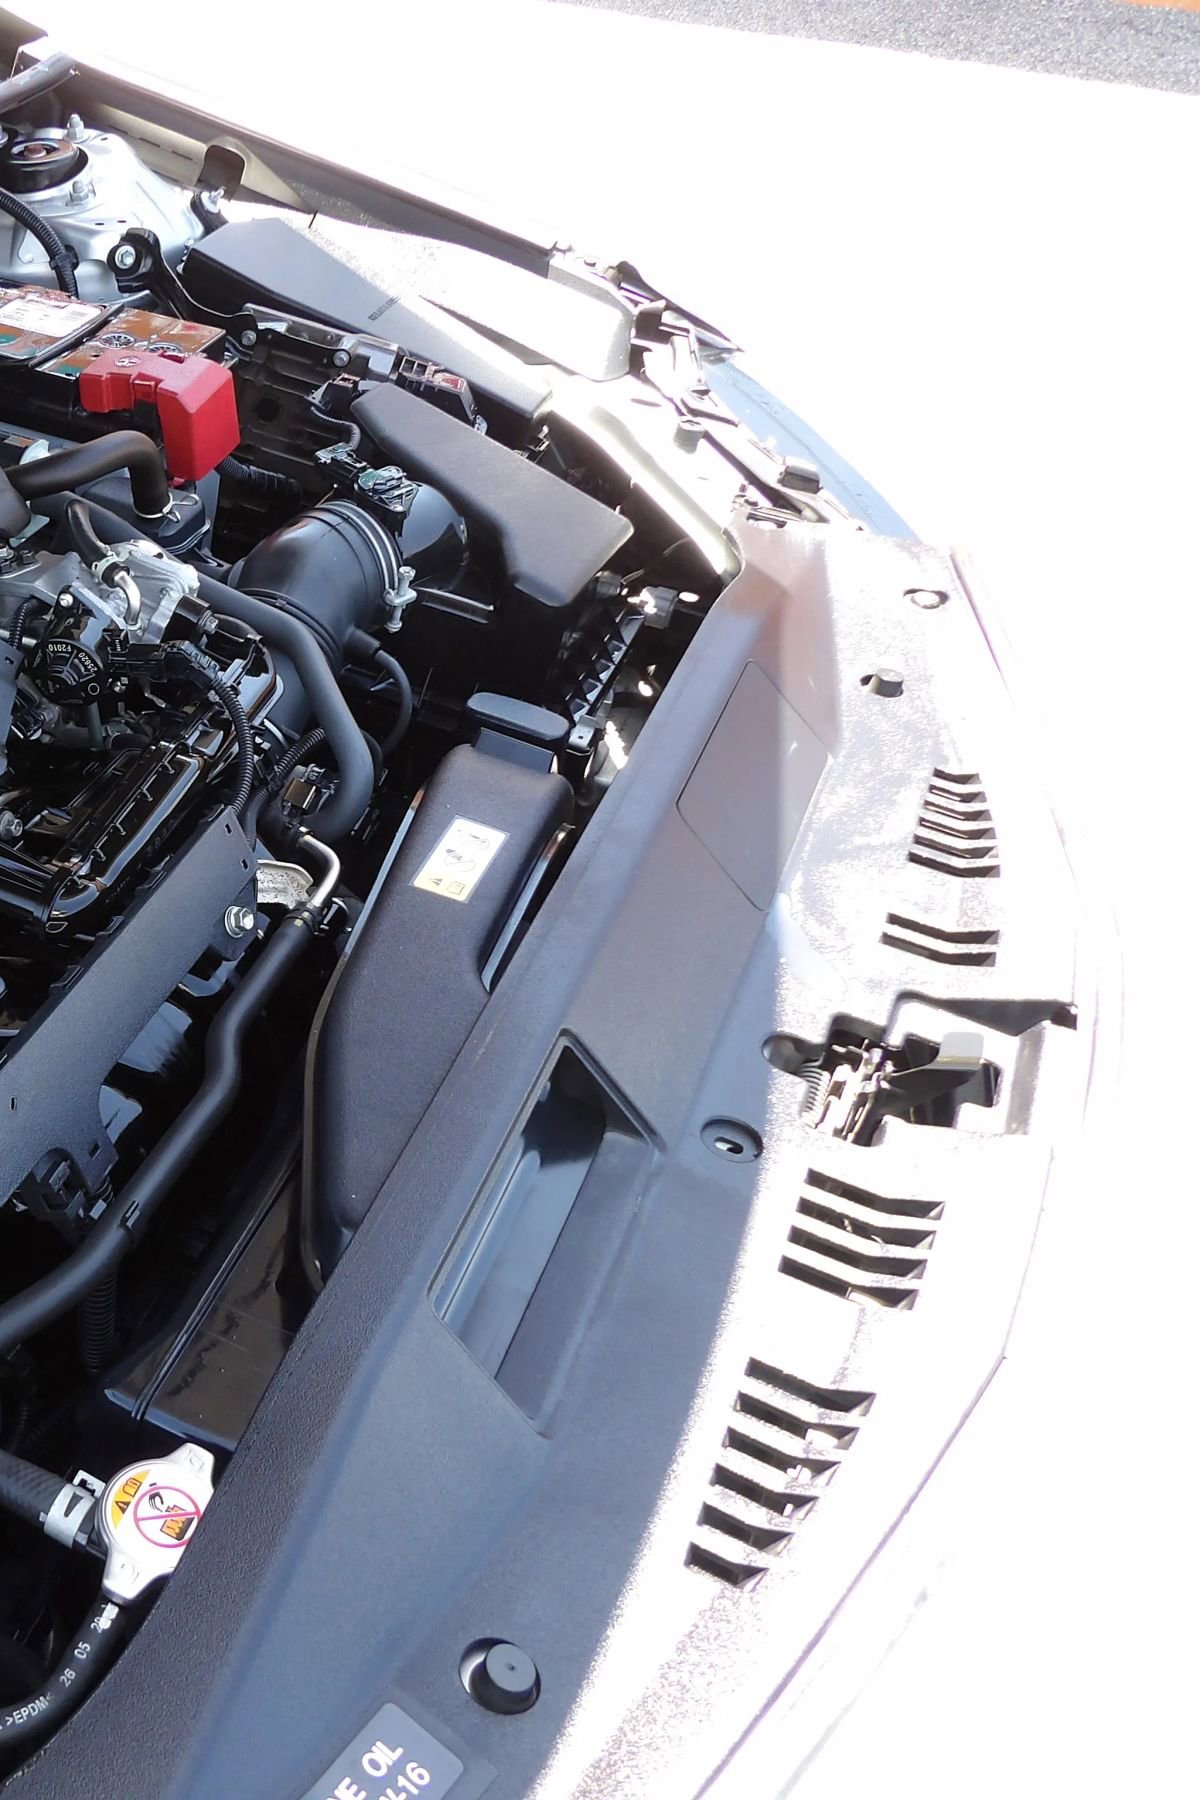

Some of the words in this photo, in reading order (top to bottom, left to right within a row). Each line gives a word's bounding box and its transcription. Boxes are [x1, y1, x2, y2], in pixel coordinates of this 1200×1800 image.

[59, 1668, 76, 1688] 26
[74, 1641, 91, 1659] 05
[361, 1740, 404, 1777] OIL
